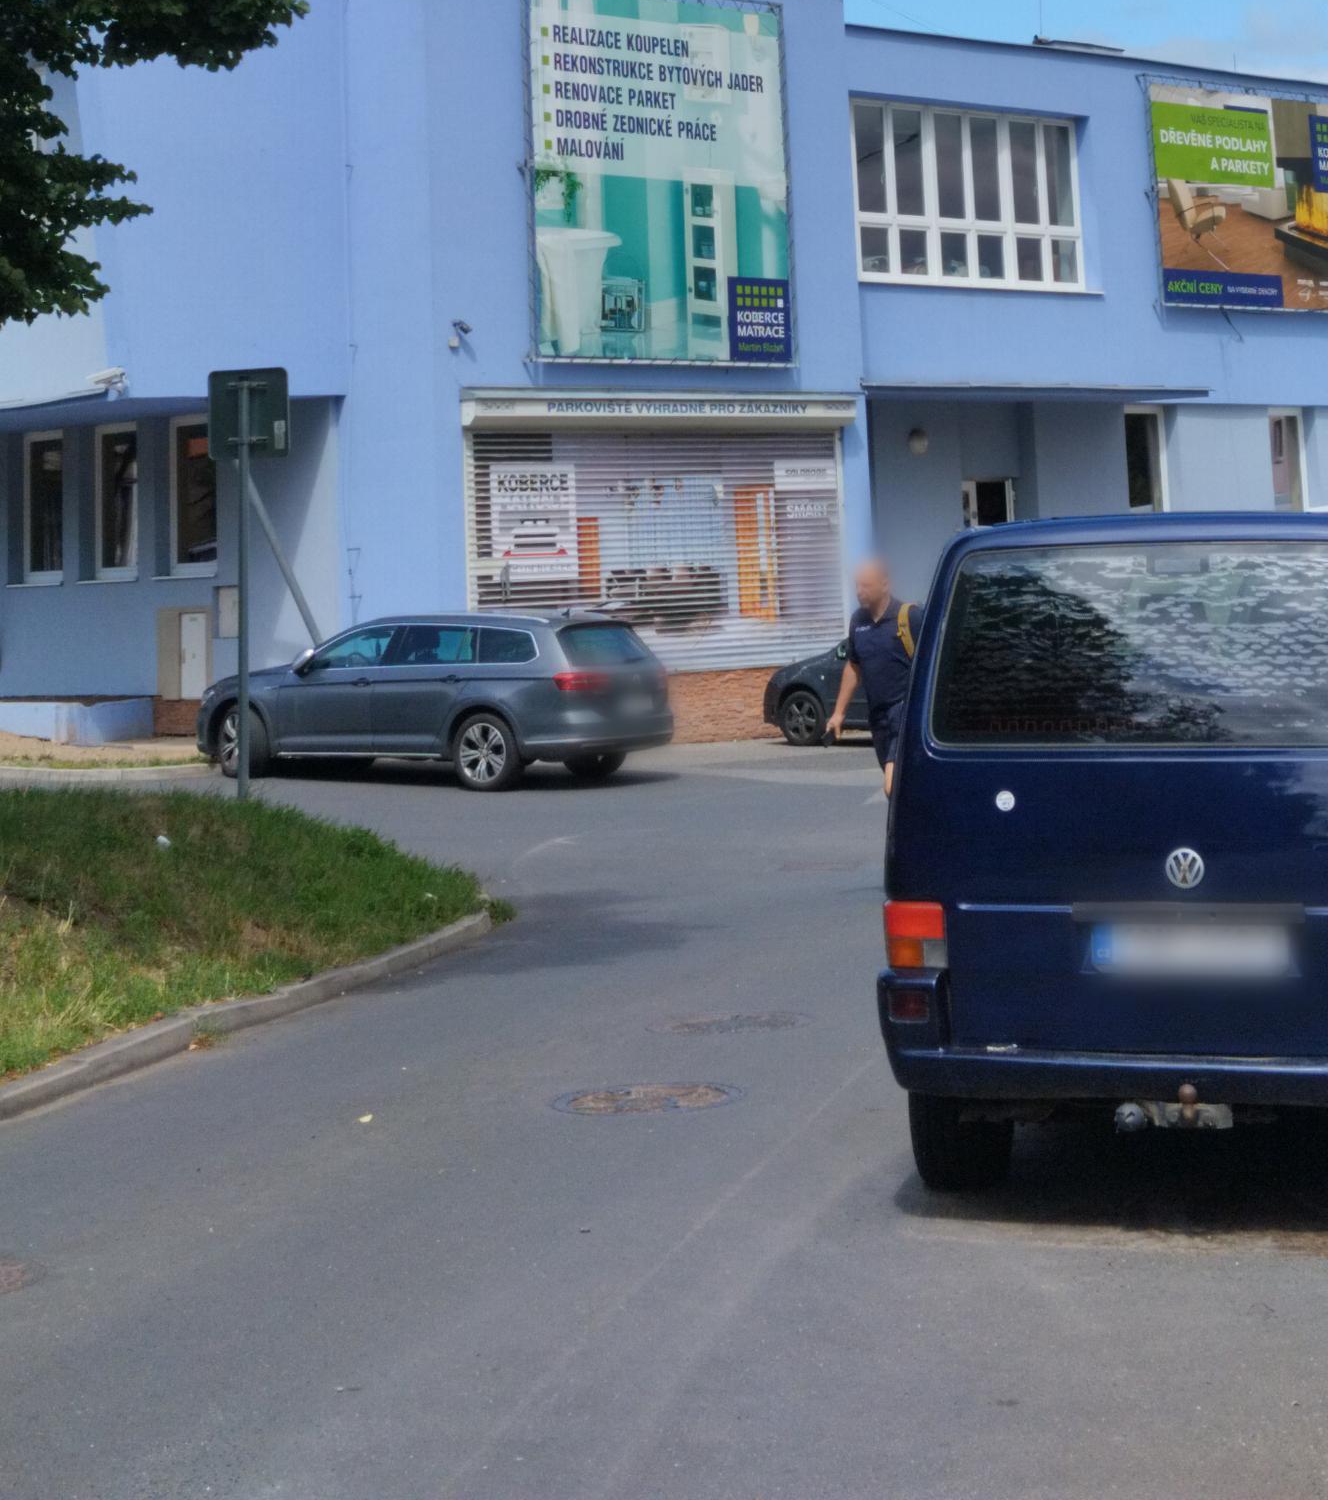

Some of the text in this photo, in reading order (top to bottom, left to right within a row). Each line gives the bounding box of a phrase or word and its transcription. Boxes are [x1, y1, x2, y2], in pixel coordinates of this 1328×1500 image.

[553, 25, 689, 58] REALIZACE KOUPELEN
[554, 53, 763, 93] REKONSTRUKCE BYTOVÝCH JADER
[555, 81, 676, 110] RENOVACE PARKET
[556, 108, 717, 141] DROBNÉ ZEDNICKÉ PRÁCE
[557, 137, 624, 160] MALOVÁNÍ
[1160, 127, 1267, 153] DŘEVĚNÉ PODLAHY
[1210, 157, 1270, 175] A PARKETY
[1167, 279, 1197, 293] AKČNÍ
[1199, 282, 1223, 294] CENY
[737, 311, 784, 324] KOBERCE
[737, 325, 784, 338] MATRACE
[547, 400, 807, 414] PARKOVIŠTĚ VÝHRADNĚ PRO ZÁKAZNÍKY
[497, 474, 569, 492] KOBERCE
